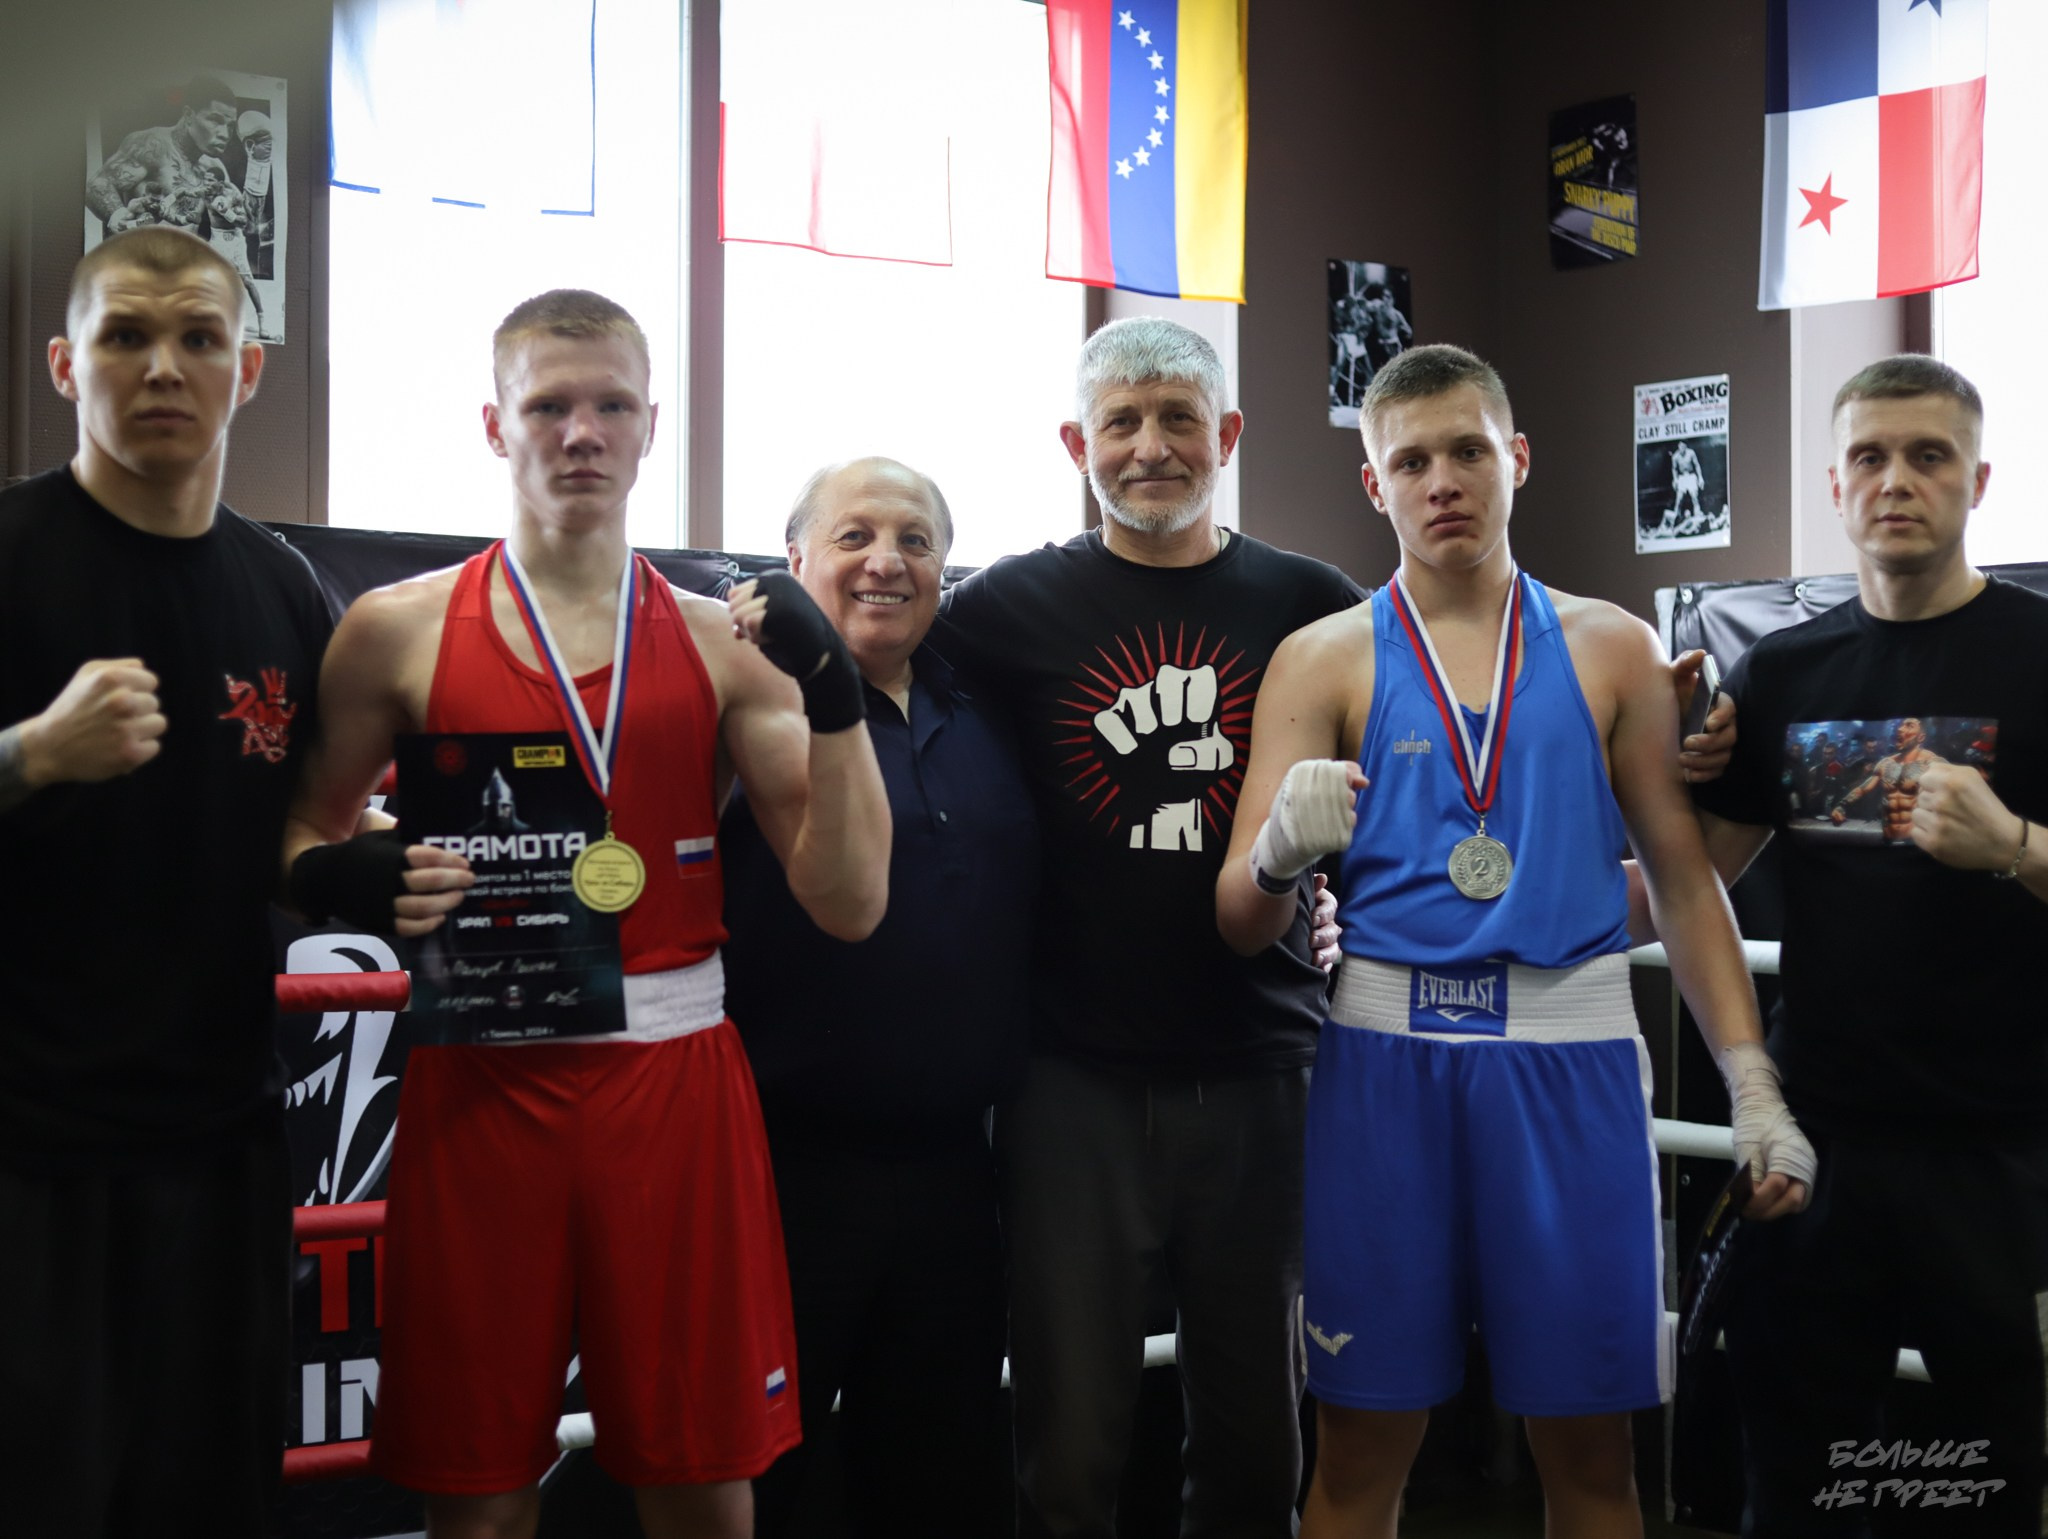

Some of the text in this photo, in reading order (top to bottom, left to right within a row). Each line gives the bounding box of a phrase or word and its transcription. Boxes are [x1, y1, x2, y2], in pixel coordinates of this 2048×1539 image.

[1660, 382, 1728, 416] BOXING
[1638, 417, 1726, 440] CLAY STILL CHAMP
[1393, 738, 1432, 755] clinch
[524, 869, 530, 880] 1
[533, 869, 572, 880] место
[1474, 855, 1490, 876] 2
[457, 916, 491, 928] УРАЛ
[516, 912, 570, 927] СИБИРЬ
[1418, 970, 1500, 1015] EVERLAST
